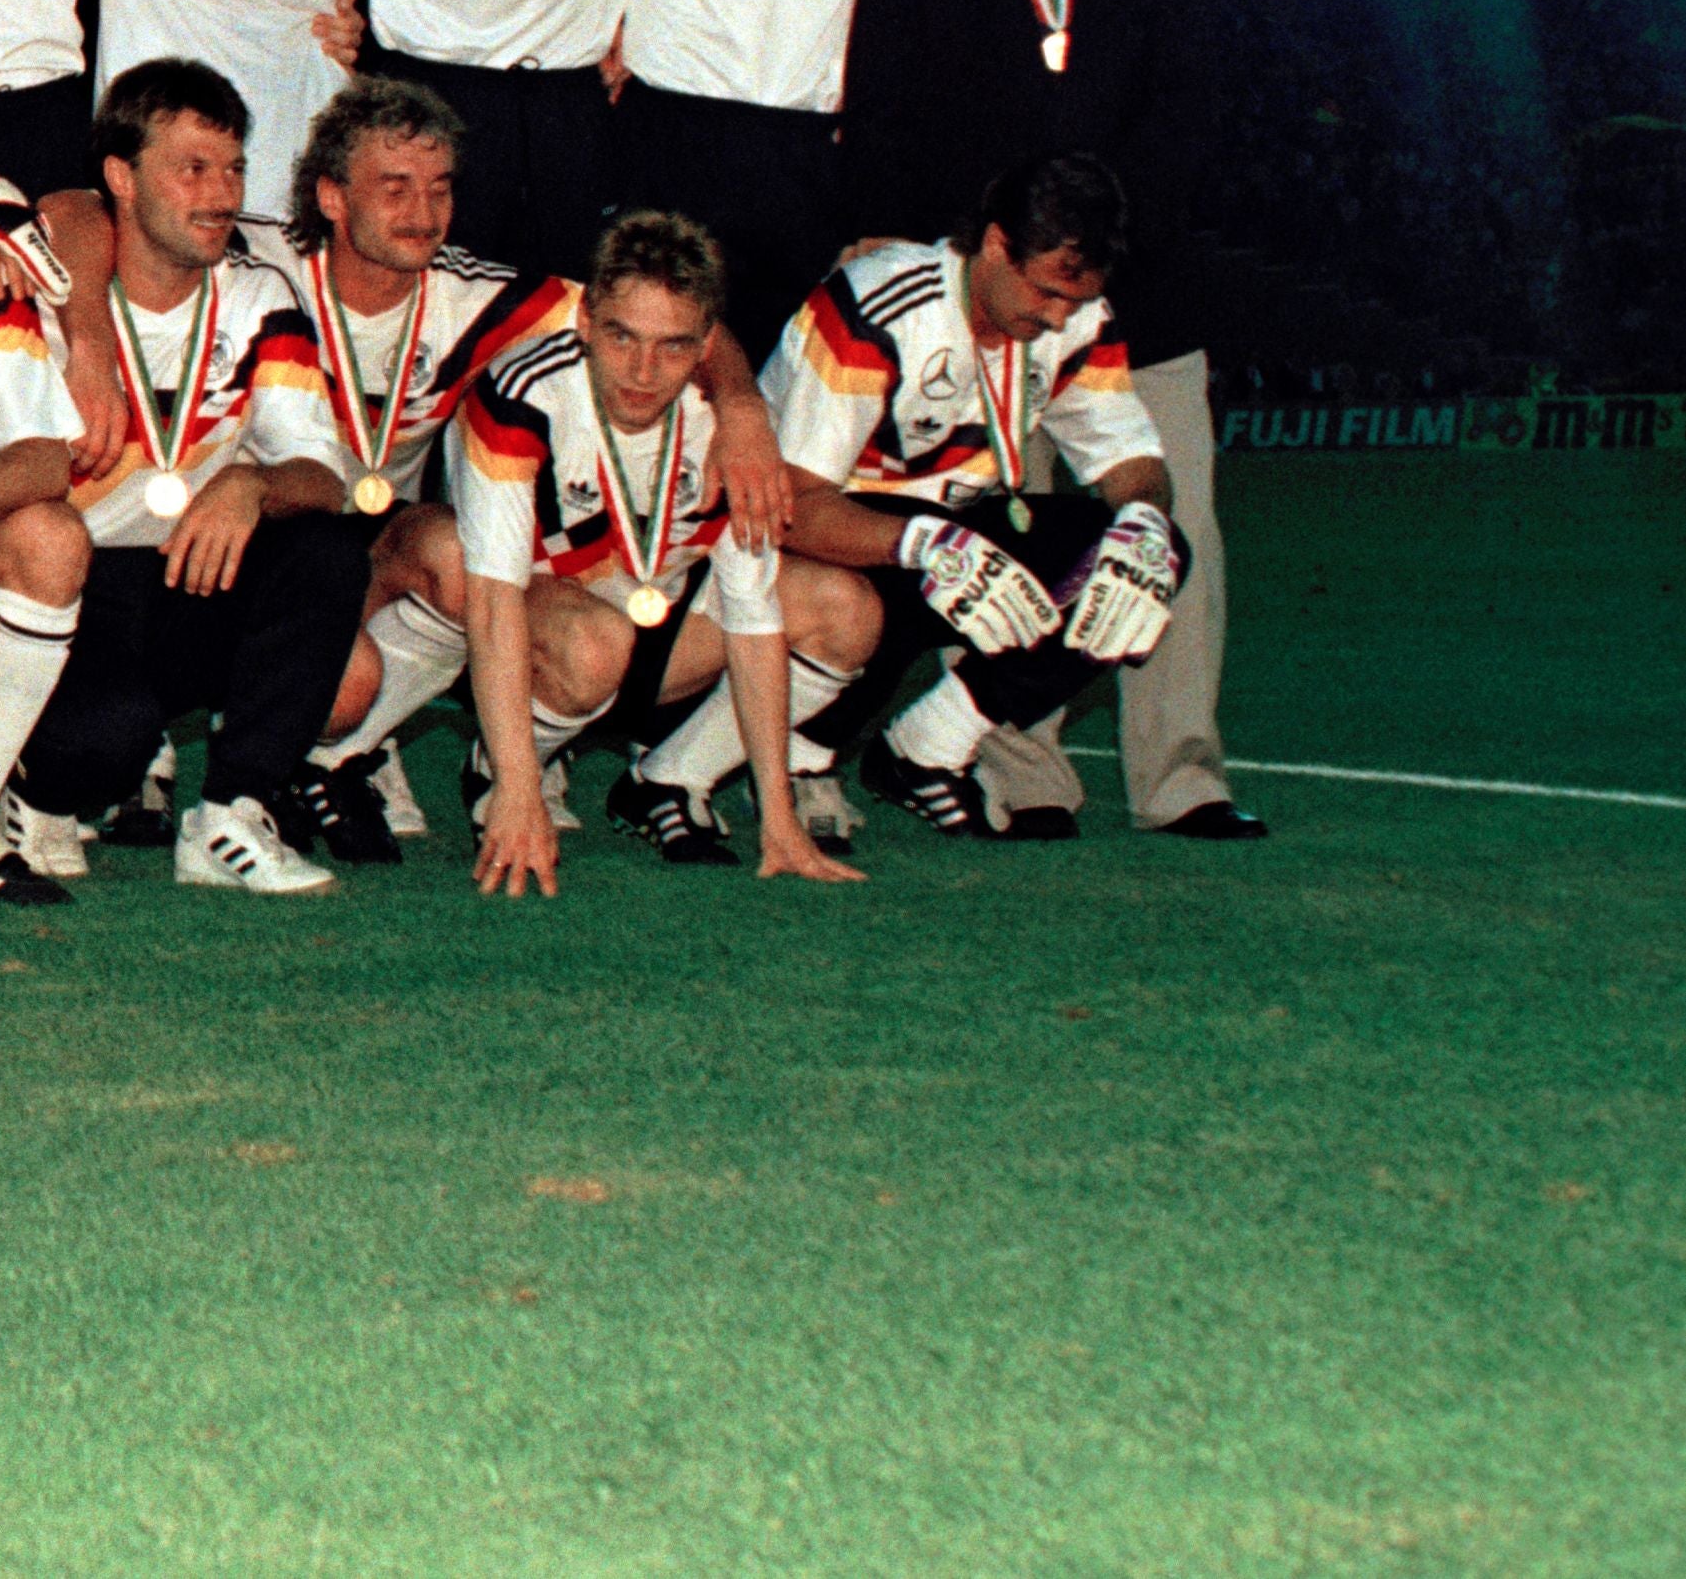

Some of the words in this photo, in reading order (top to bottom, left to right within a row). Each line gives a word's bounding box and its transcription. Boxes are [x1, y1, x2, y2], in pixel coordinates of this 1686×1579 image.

[1222, 406, 1329, 448] FUJI
[1336, 405, 1457, 447] FILM
[946, 549, 1015, 627] reusch
[1012, 571, 1053, 624] reusch
[1075, 582, 1110, 639] reusch
